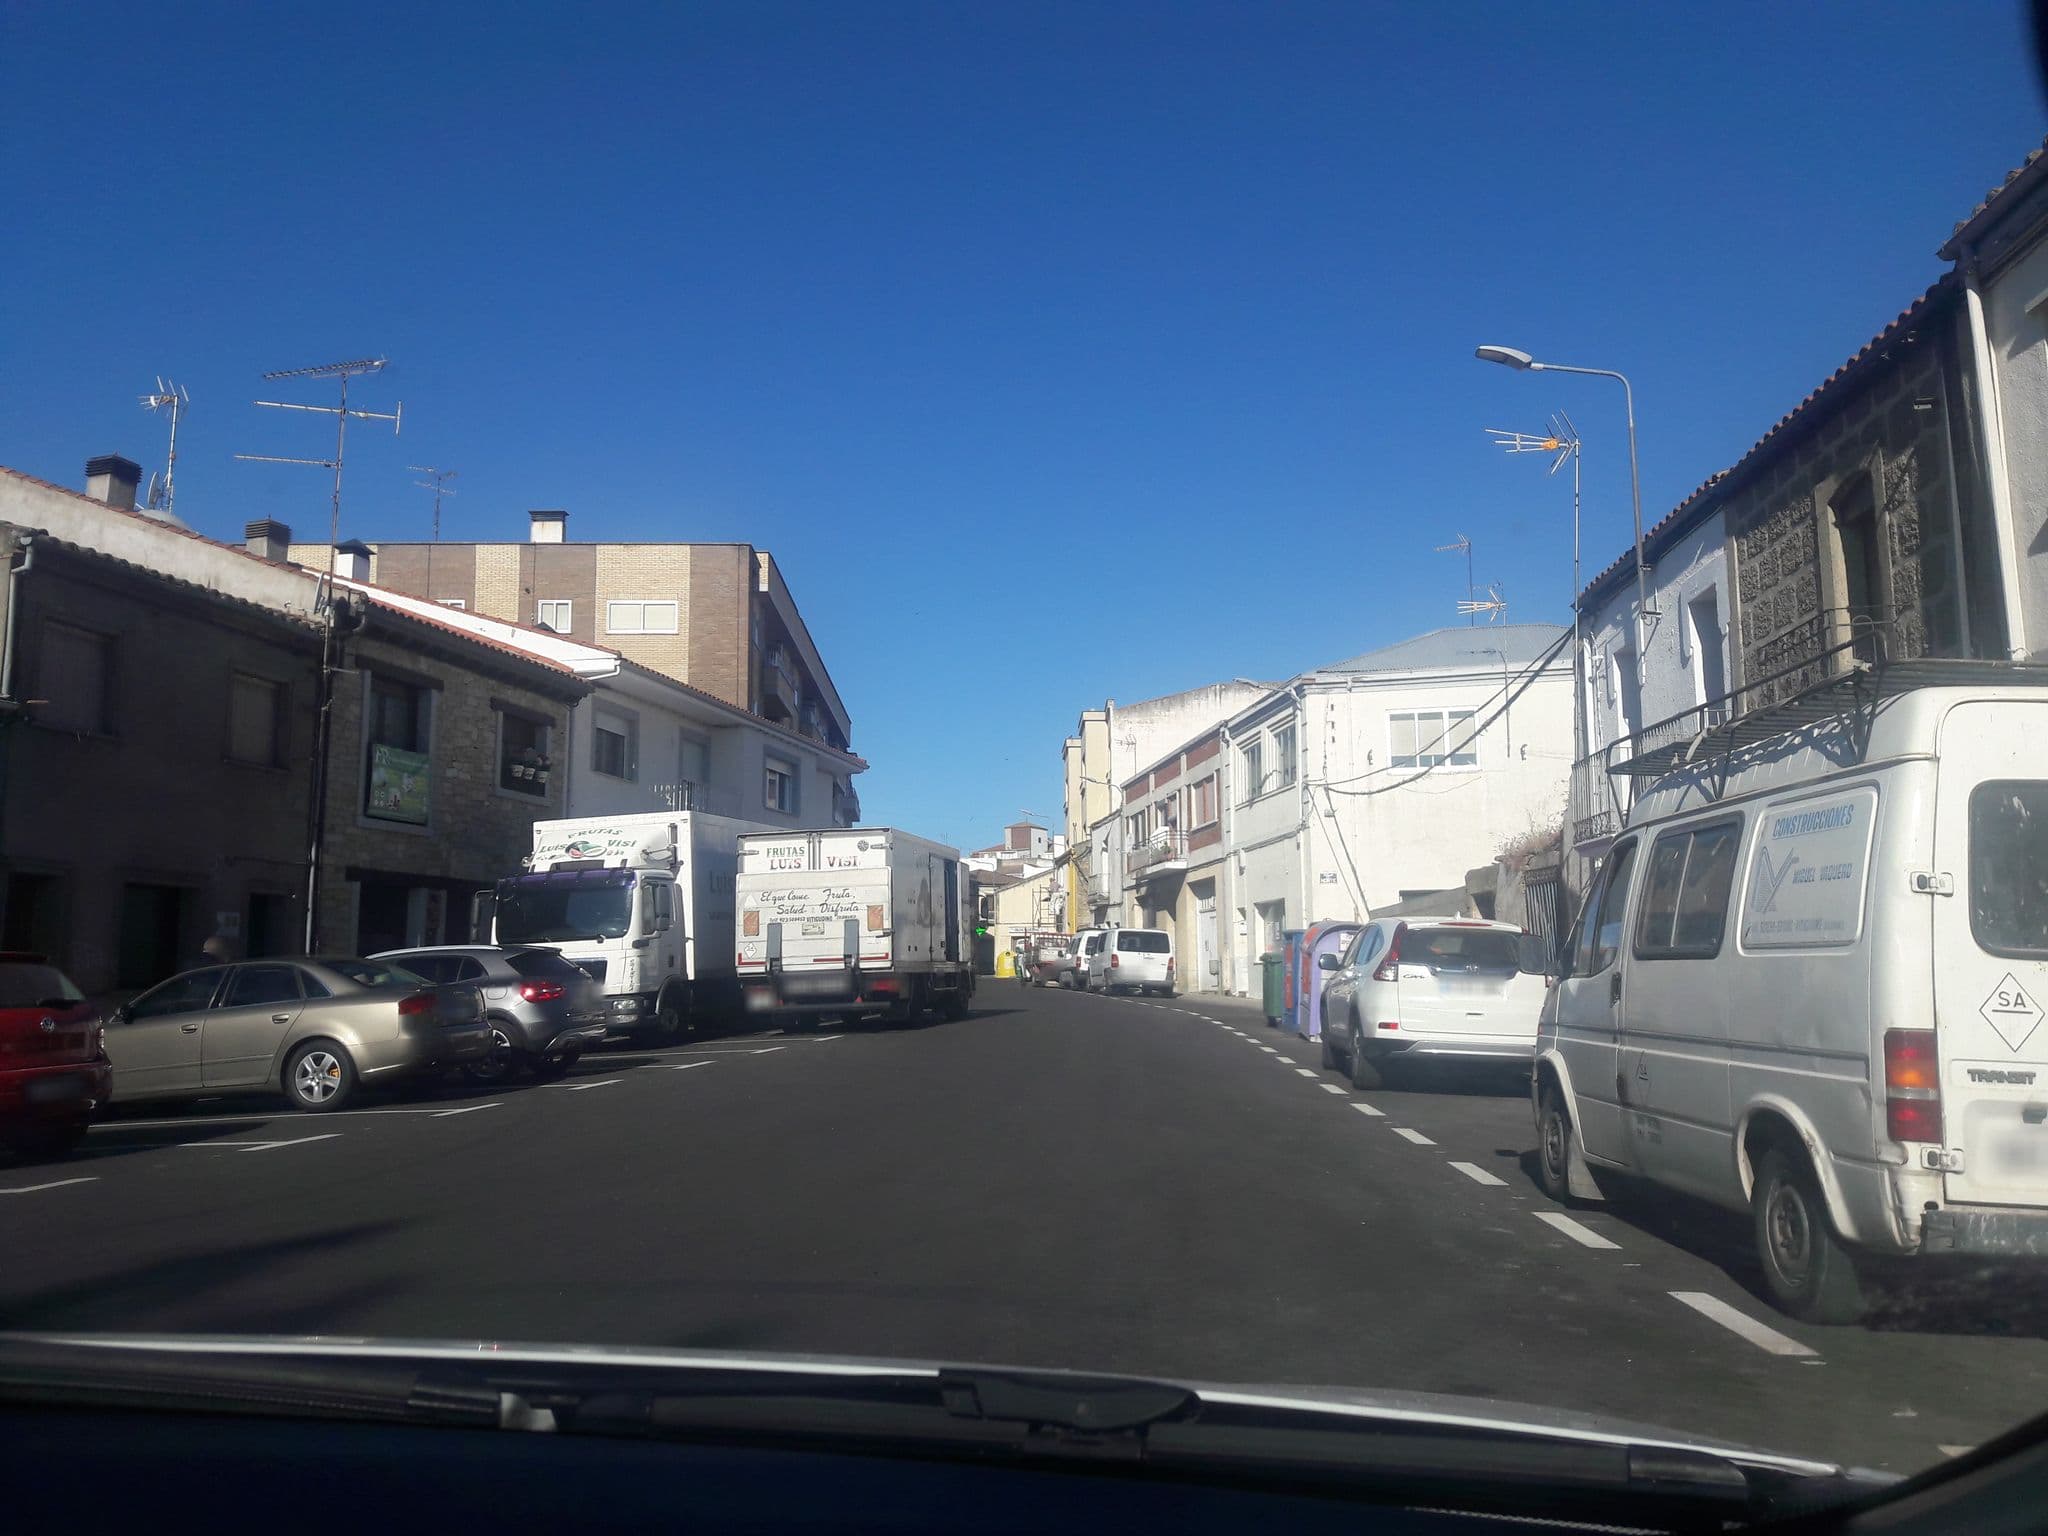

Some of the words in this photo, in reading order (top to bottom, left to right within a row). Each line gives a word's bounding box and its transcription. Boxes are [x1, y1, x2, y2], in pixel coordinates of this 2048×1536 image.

[1772, 804, 1854, 837] CONSTRUCCIONES
[568, 828, 623, 839] FRUTAS
[540, 843, 568, 853] LUIS
[608, 839, 637, 849] VISI
[767, 846, 805, 857] FRUTAS
[770, 858, 802, 870] LUIS
[826, 855, 859, 868] VISI
[1998, 991, 2026, 1008] SA
[1966, 1068, 2037, 1085] TRANSIT
